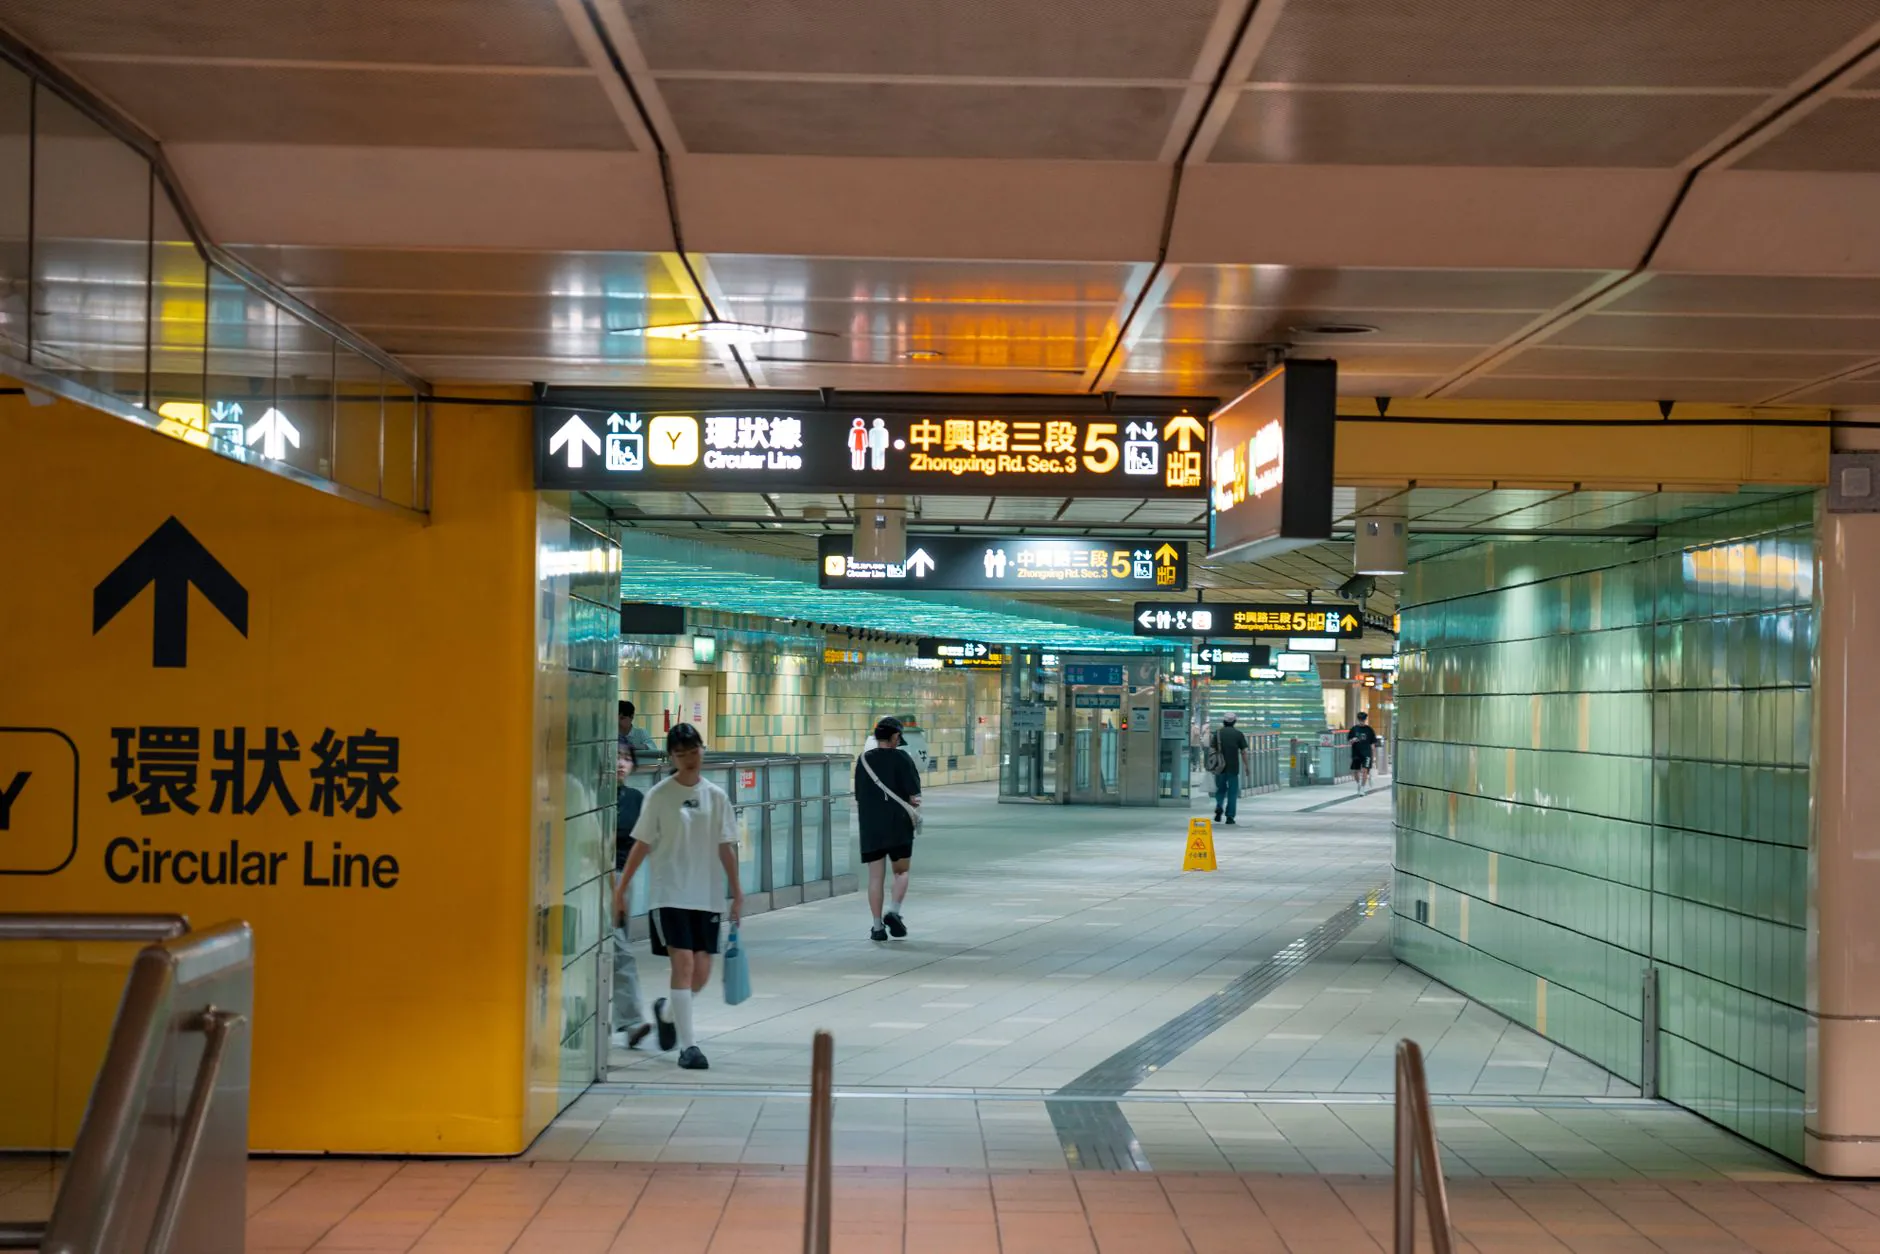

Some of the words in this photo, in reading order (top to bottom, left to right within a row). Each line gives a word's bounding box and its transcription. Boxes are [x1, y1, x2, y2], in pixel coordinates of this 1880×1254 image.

[666, 431, 682, 450] Y
[910, 419, 1077, 453] 中興路三段
[1082, 423, 1120, 473] 5
[703, 450, 766, 469] Circular
[767, 451, 802, 470] Line
[910, 453, 996, 476] Zhongxing
[997, 454, 1025, 472] Rd.
[1026, 452, 1064, 473] Sec.
[1065, 453, 1078, 473] 3
[1166, 451, 1202, 487] 出口
[1017, 550, 1108, 567] 中三段
[1111, 551, 1132, 578] 5
[1157, 566, 1176, 585] 出口
[1292, 612, 1306, 630] 5
[107, 726, 402, 819] 環狀線
[104, 837, 287, 886] Circular
[303, 841, 399, 888] Line
